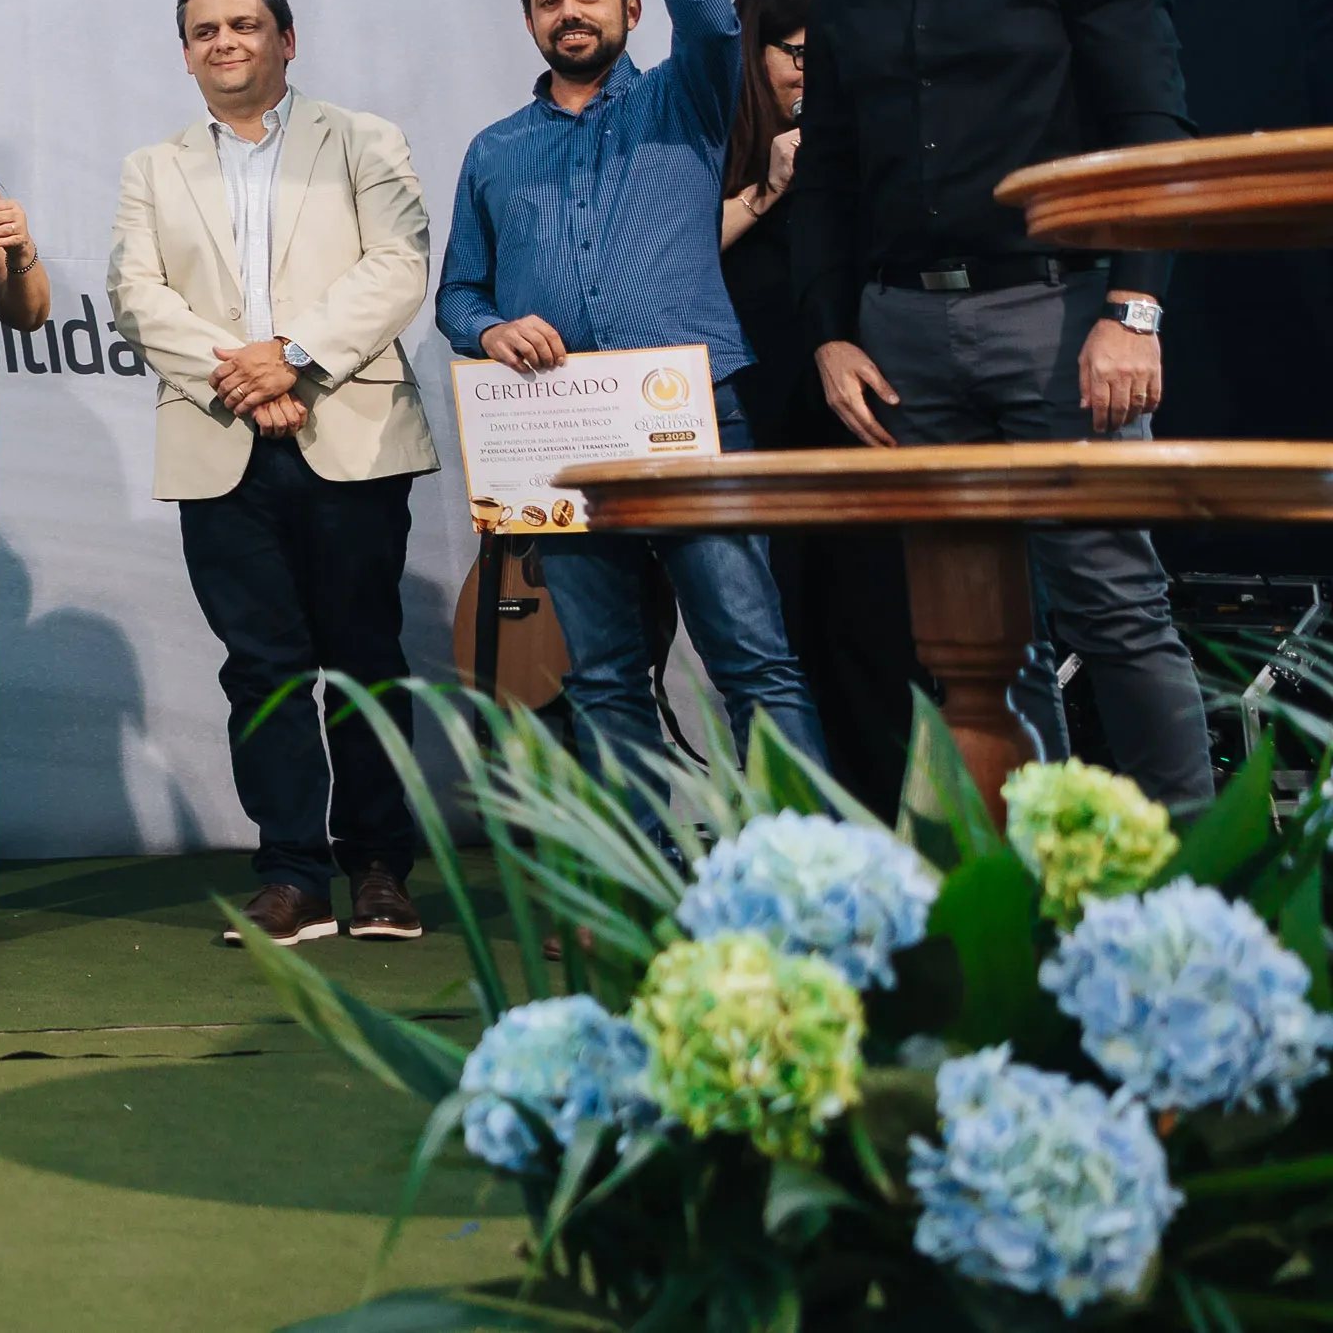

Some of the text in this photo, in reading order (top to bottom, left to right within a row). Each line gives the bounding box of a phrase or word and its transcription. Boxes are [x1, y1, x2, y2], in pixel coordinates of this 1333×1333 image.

[475, 377, 618, 401] CERTIFICADO
[490, 422, 519, 432] DAVID
[552, 420, 580, 429] FARIA
[581, 418, 612, 427] BISCO
[634, 418, 705, 432] QUALIDADE
[665, 432, 693, 441] 2025
[487, 447, 527, 455] COLOCAÇÃO
[582, 442, 630, 450] FERMENTADO
